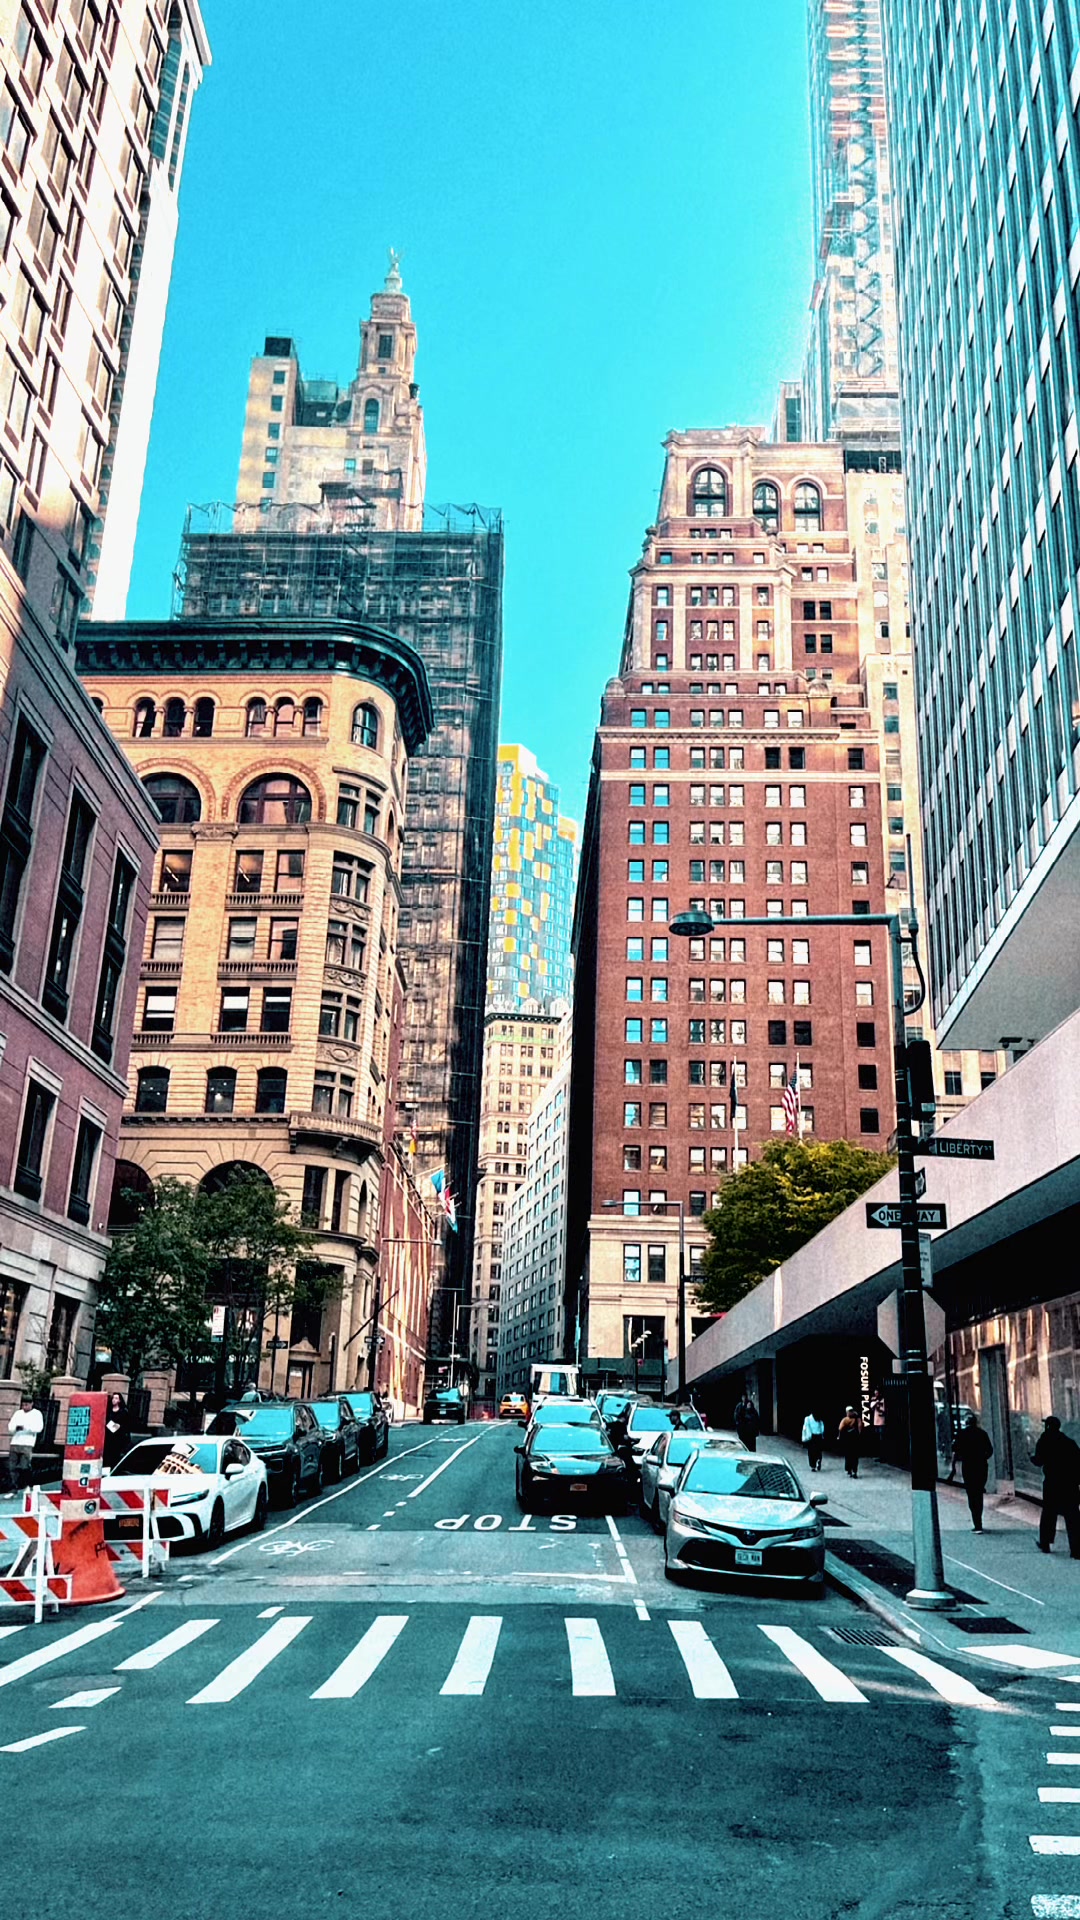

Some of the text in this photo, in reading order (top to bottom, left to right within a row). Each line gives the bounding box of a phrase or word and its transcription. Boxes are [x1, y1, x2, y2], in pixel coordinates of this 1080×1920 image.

[939, 1141, 984, 1156] LIBERTY
[878, 1211, 901, 1223] ONE
[859, 1356, 871, 1428] FOSUN PLAZA
[433, 1514, 578, 1531] STOP
